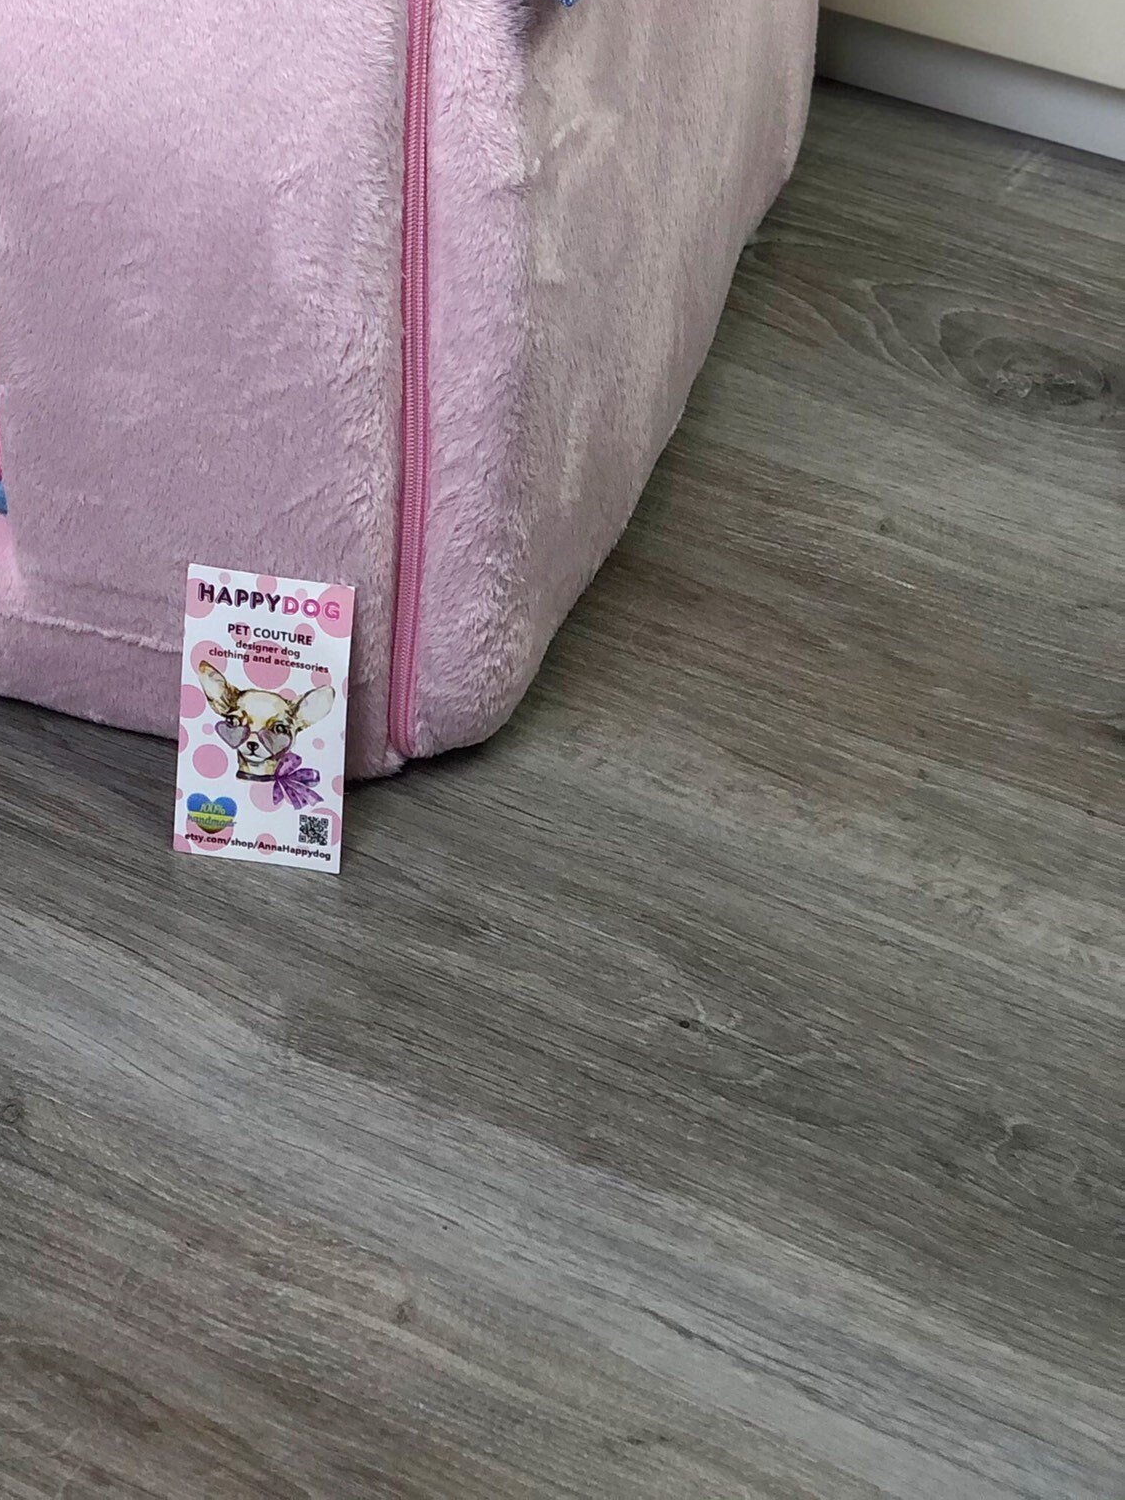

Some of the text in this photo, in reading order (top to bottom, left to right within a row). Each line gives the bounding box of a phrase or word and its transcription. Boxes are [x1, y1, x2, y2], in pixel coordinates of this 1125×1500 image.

[227, 623, 313, 646] PET COUTURE
[208, 647, 329, 674] clothing and accessories
[235, 639, 301, 660] designer dog
[199, 802, 226, 815] 100%
[184, 832, 331, 861] etsy.com/shop/AnnaHappydog
